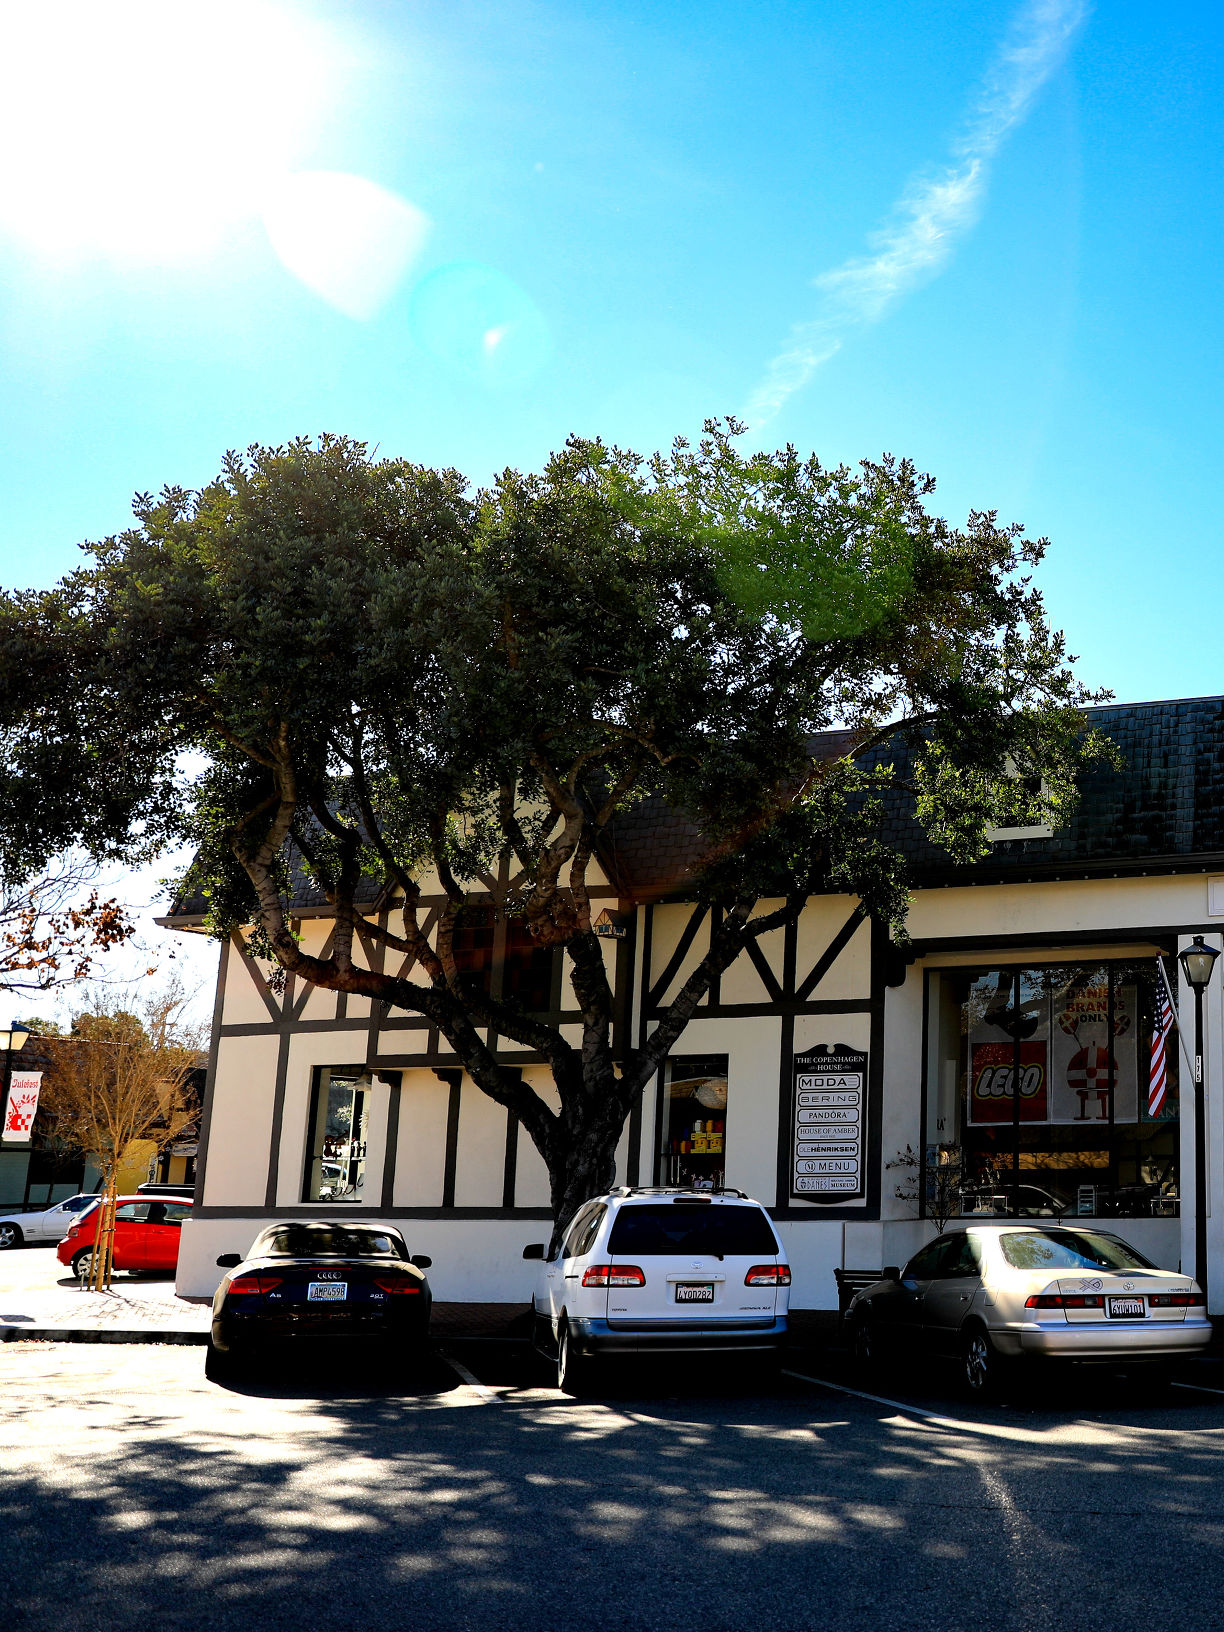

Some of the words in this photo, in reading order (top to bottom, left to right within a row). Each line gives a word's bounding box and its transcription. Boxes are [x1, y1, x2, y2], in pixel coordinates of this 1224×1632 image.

[812, 1055, 865, 1063] COPENHAGEN
[801, 1077, 848, 1087] MODA
[977, 1066, 1041, 1097] LEGO
[801, 1095, 857, 1103] BERING
[808, 1111, 847, 1119] PANDORA
[832, 1127, 856, 1135] AMBER
[818, 1162, 850, 1171] MENU
